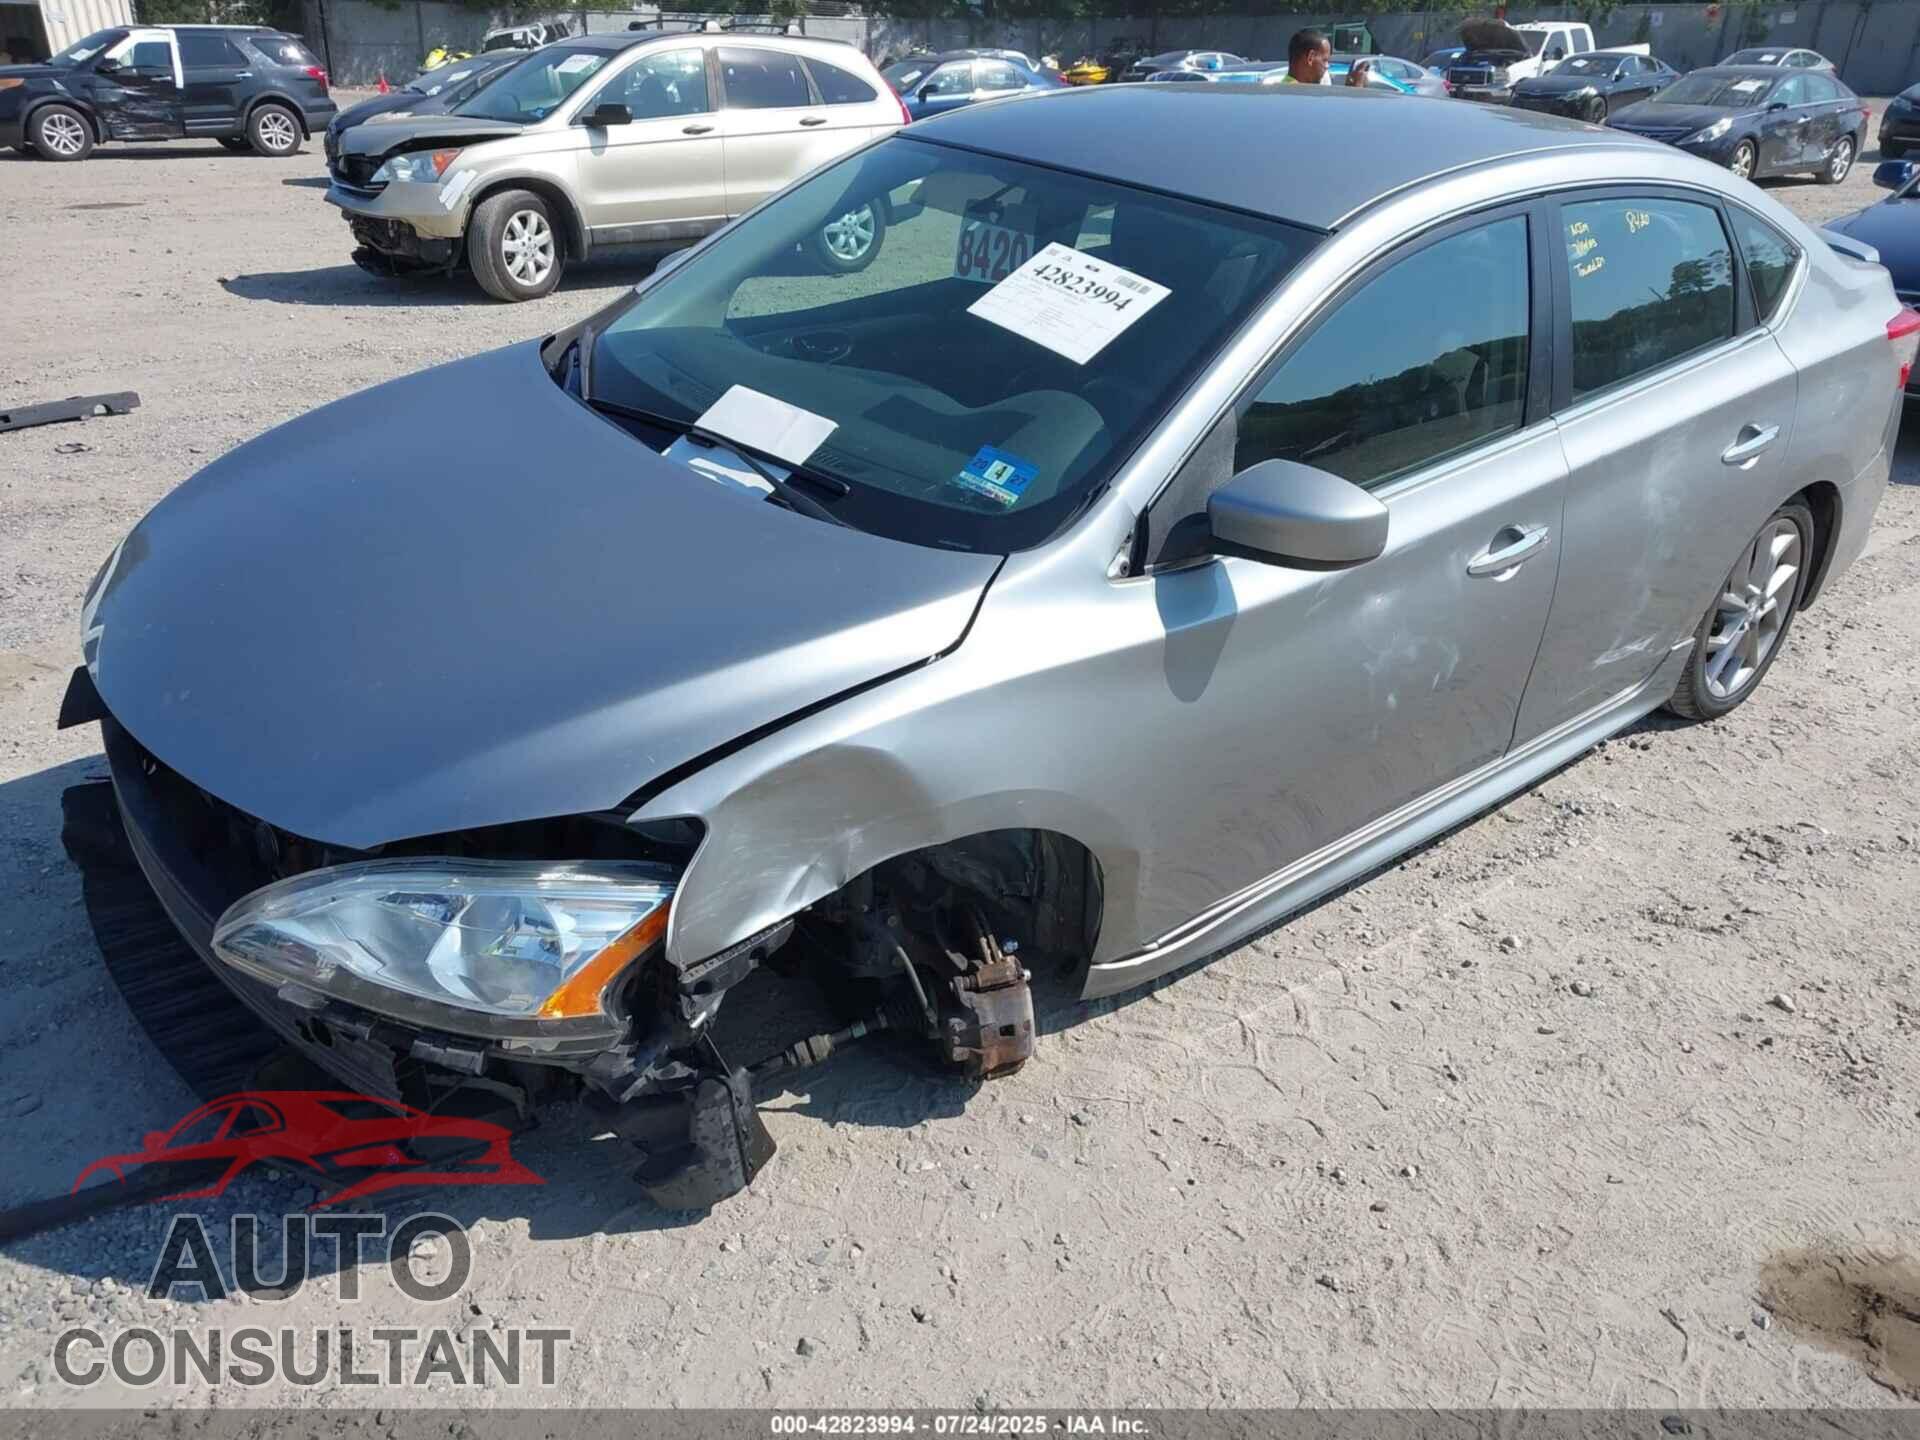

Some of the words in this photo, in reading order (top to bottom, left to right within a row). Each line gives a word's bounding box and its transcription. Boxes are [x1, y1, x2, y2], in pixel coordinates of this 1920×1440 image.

[957, 229, 1029, 282] 8420
[1033, 263, 1133, 312] 42823994
[995, 466, 1008, 480] 4
